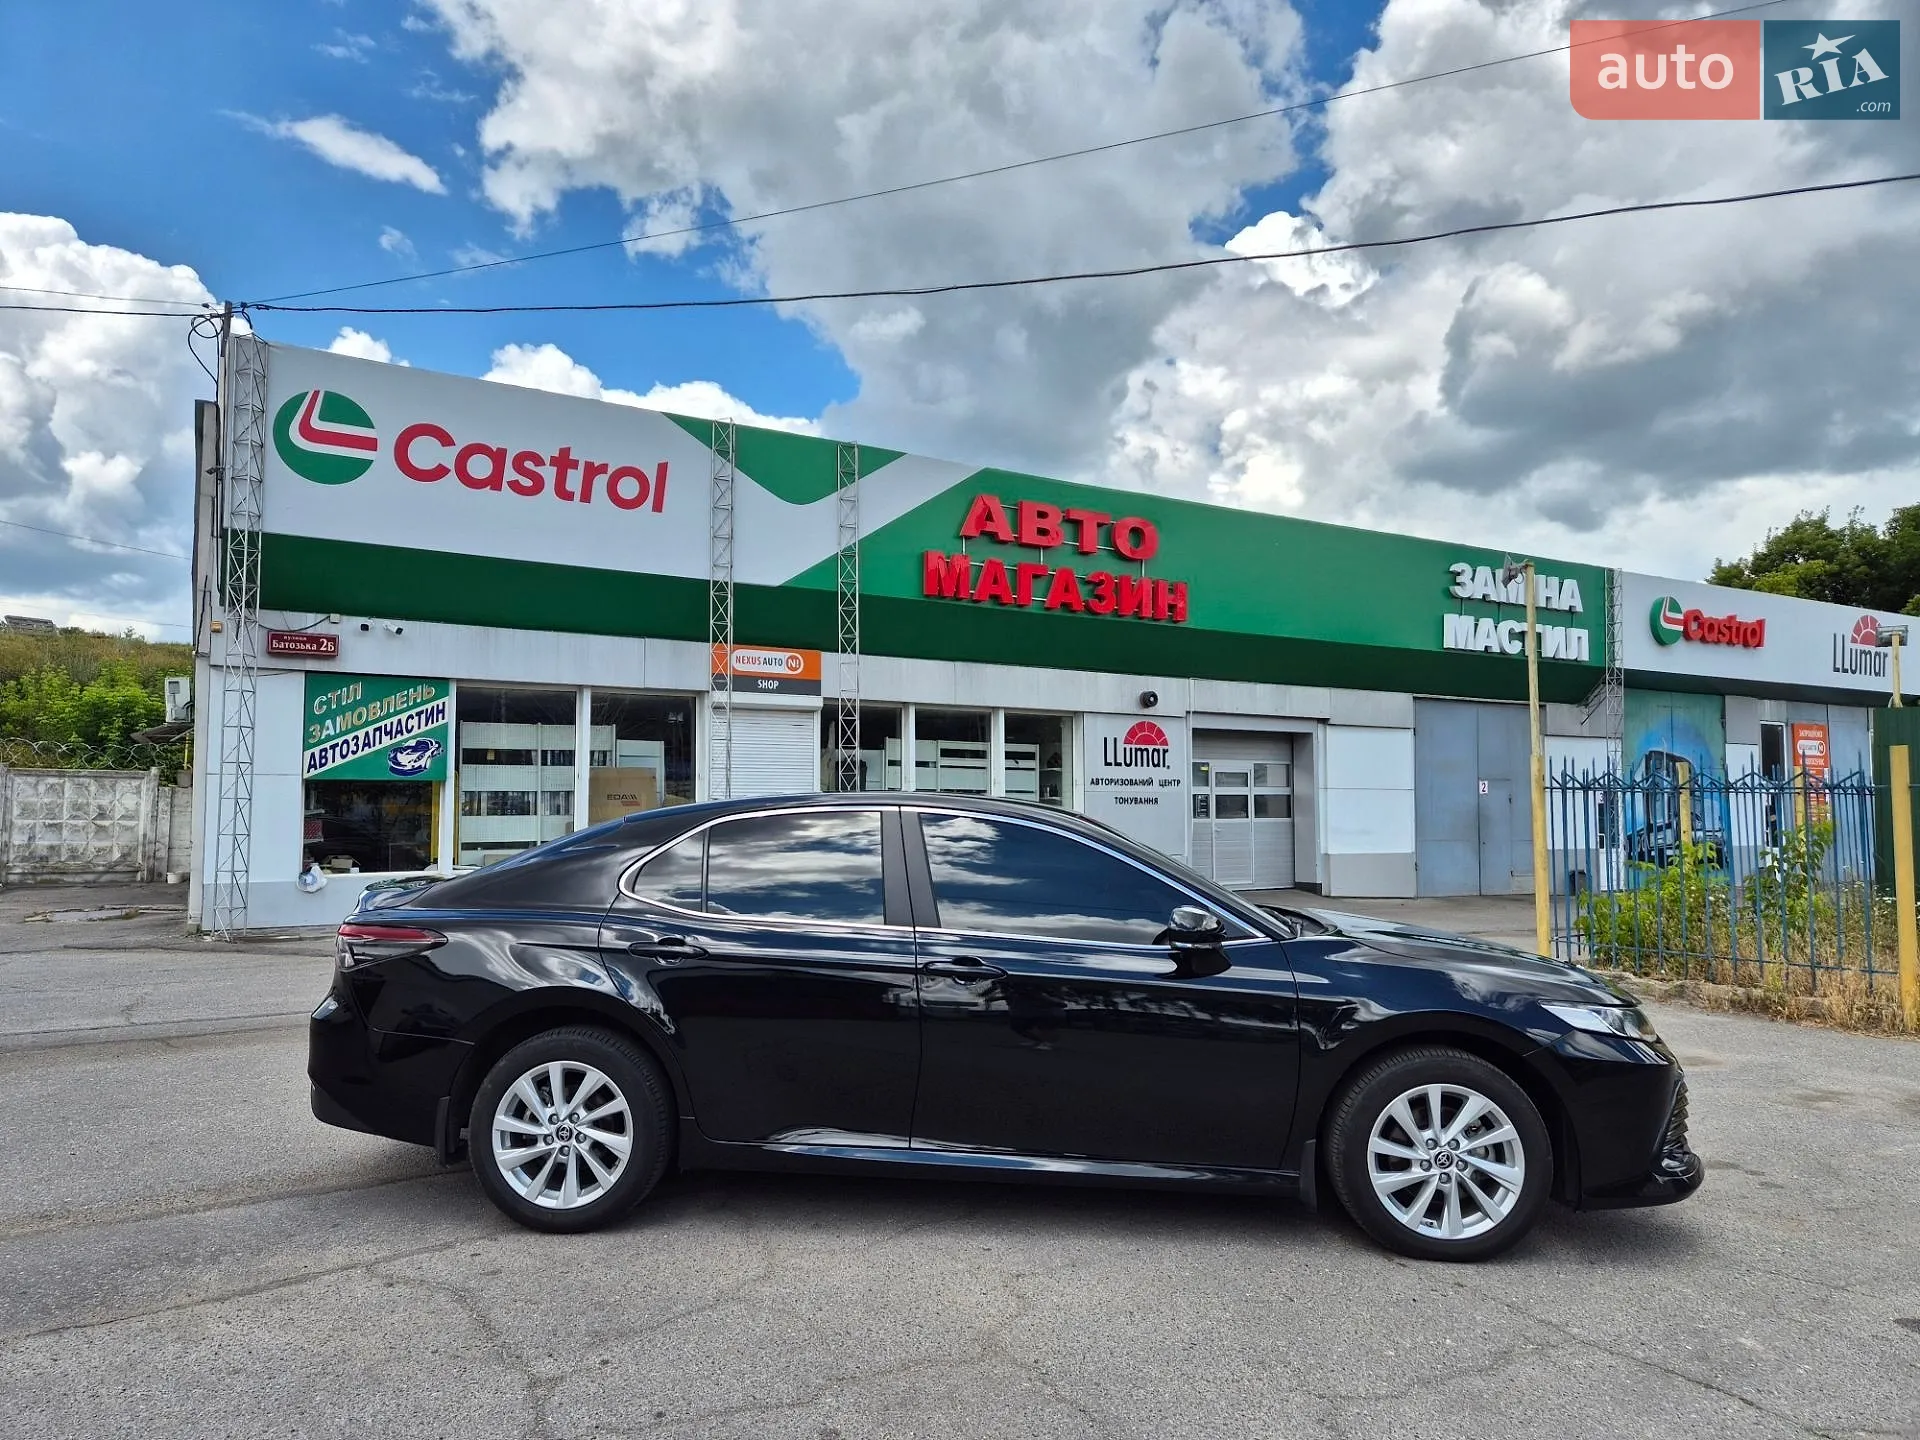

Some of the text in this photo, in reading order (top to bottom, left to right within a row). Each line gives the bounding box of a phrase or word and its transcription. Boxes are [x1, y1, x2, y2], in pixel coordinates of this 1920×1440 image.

[393, 422, 669, 514] Castrol
[960, 494, 1159, 560] АВТО
[923, 550, 1188, 622] МАГАЗИН
[1450, 562, 1584, 612] ЗАМНА
[272, 638, 335, 652] Батозька 2Б
[1683, 608, 1767, 648] Castrol
[735, 655, 761, 666] NEXUS
[762, 656, 783, 667] AUTO
[1832, 632, 1889, 678] LLumar
[313, 680, 362, 715] СТІЛ
[757, 679, 780, 690] SHOP
[308, 683, 436, 744] ЗАМОВЛЕНЬ
[306, 701, 446, 774] АВТОЗАПЧАСТИН
[1090, 777, 1181, 788] АВТОРИЗОВАНИЙ ЦЕНТР
[1114, 796, 1159, 805] ТОНУВАННЯ
[1481, 782, 1487, 793] 2
